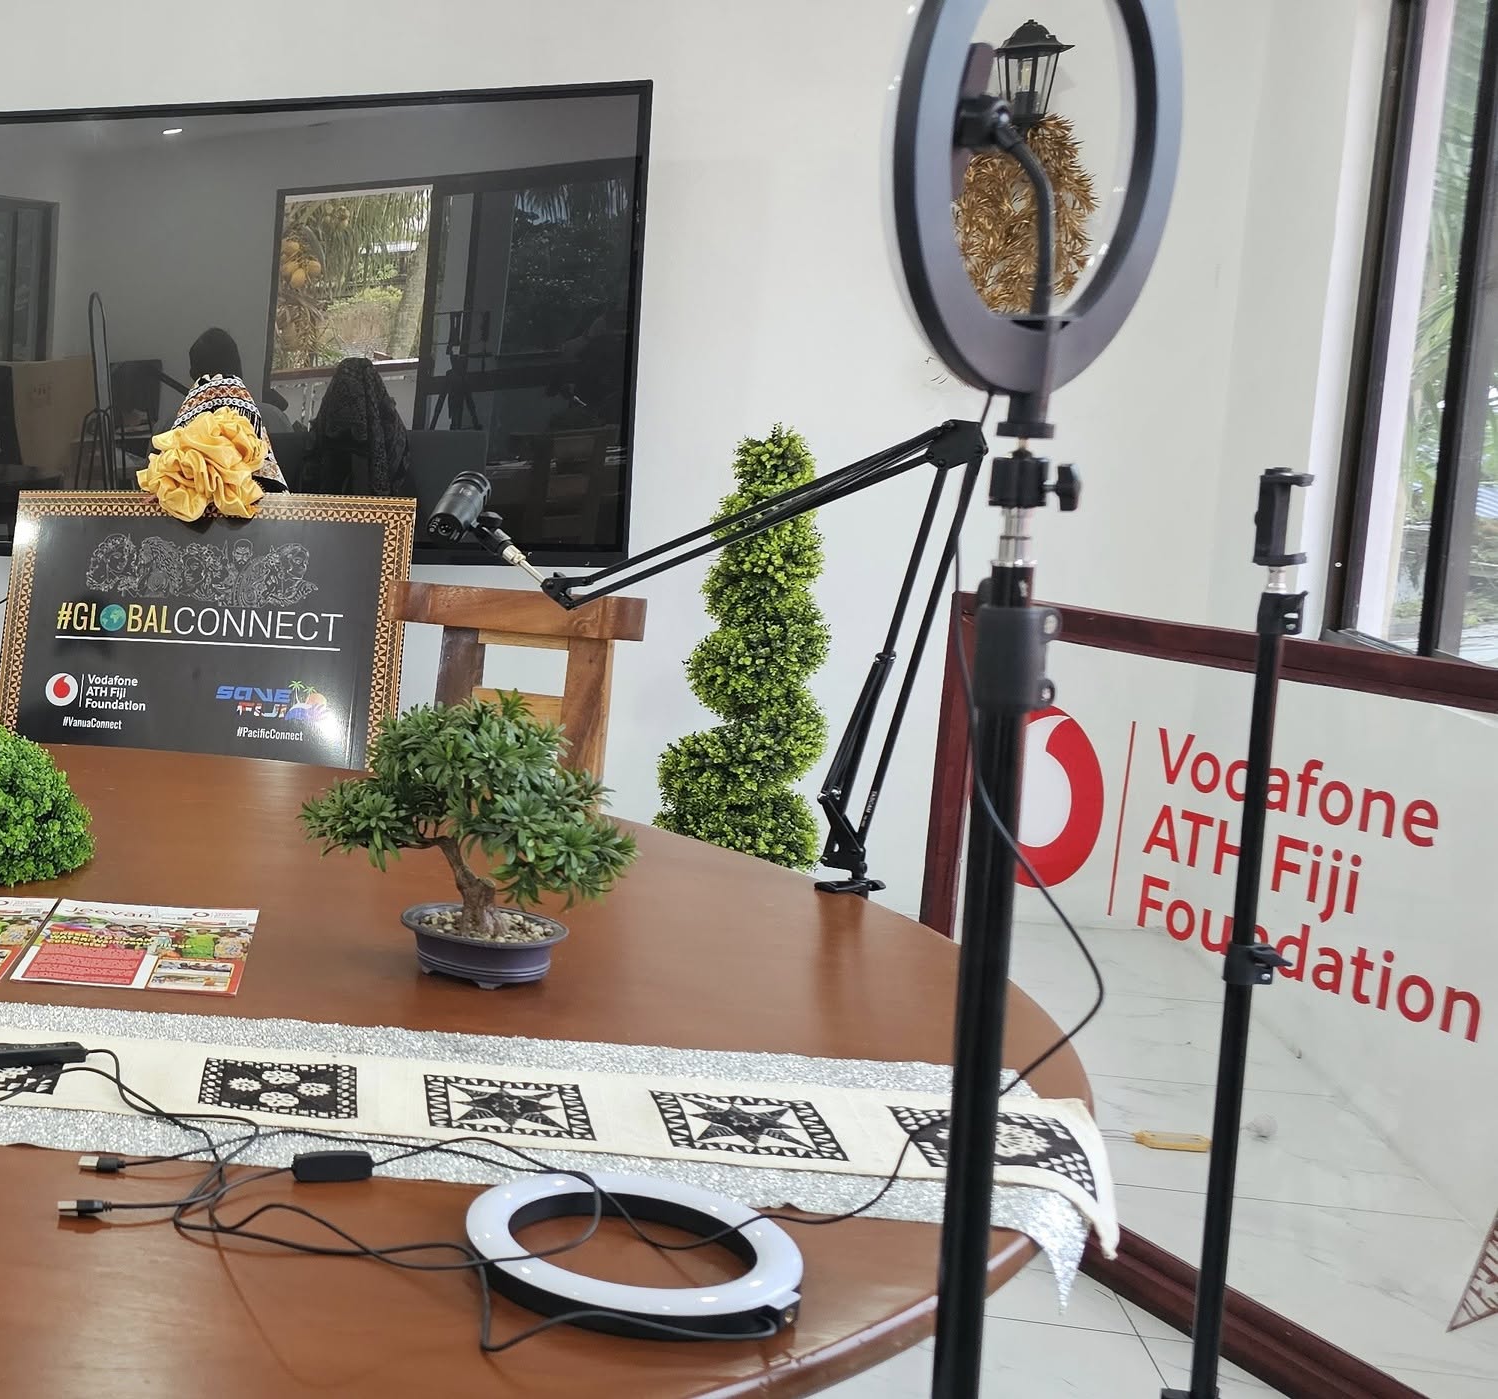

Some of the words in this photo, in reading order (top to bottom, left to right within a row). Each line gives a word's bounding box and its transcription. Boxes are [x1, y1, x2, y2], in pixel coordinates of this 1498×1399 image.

[88, 674, 138, 686] Vodafone
[86, 686, 108, 697] ATH
[110, 687, 126, 700] Fiji
[85, 698, 146, 711] Foundation
[62, 716, 122, 730] #VanuaConnect
[237, 726, 303, 741] #PacificConnect
[1270, 834, 1362, 923] Fiji
